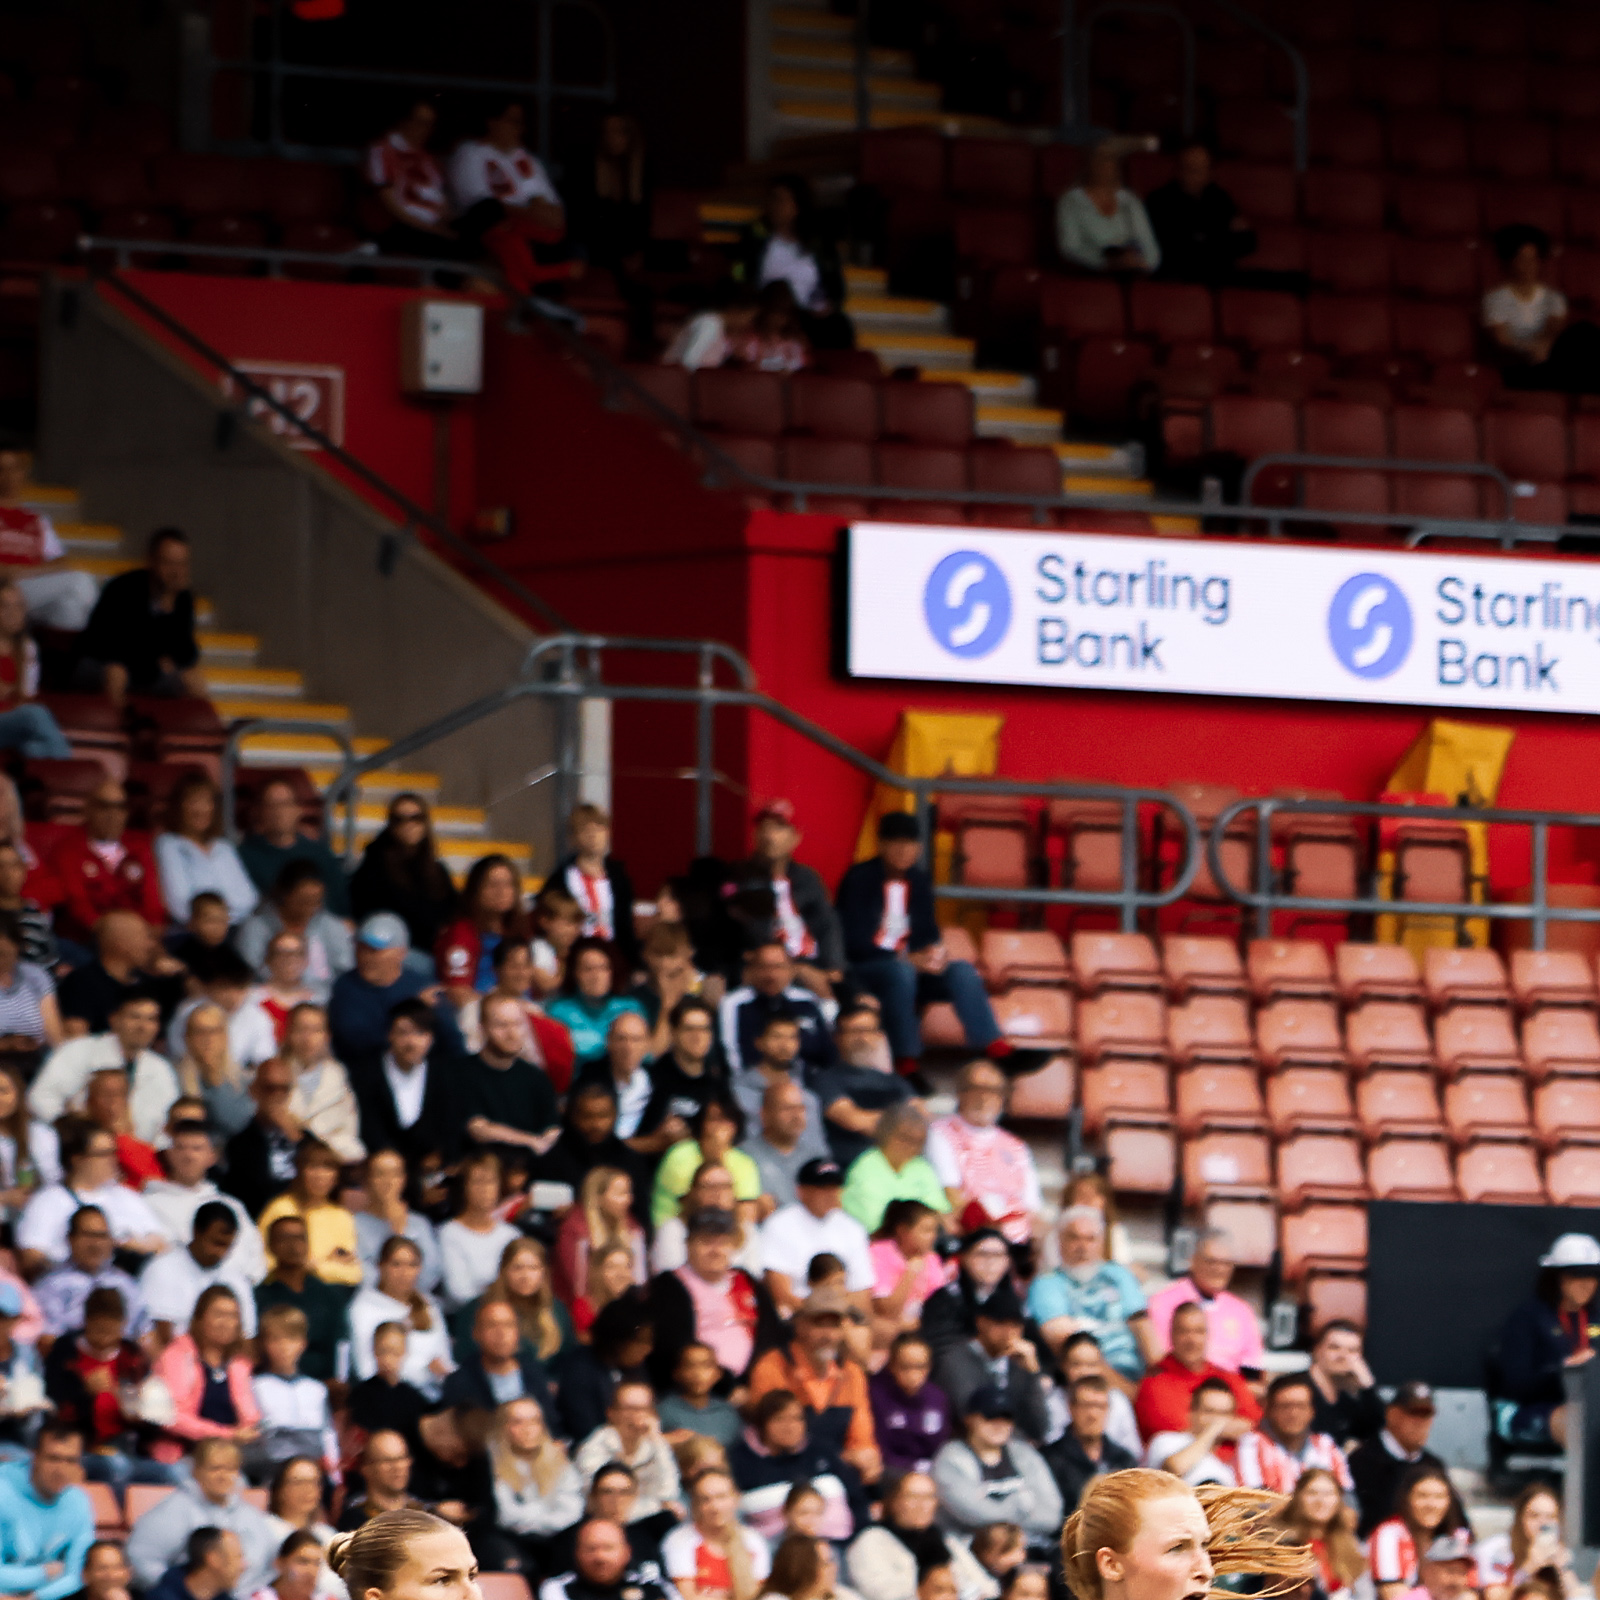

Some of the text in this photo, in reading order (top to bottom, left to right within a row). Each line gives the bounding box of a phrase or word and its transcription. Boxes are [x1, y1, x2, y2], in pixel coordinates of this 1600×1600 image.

[1036, 553, 1231, 626] Starling
[1037, 616, 1166, 671] Bank
[1438, 638, 1560, 692] Bank
